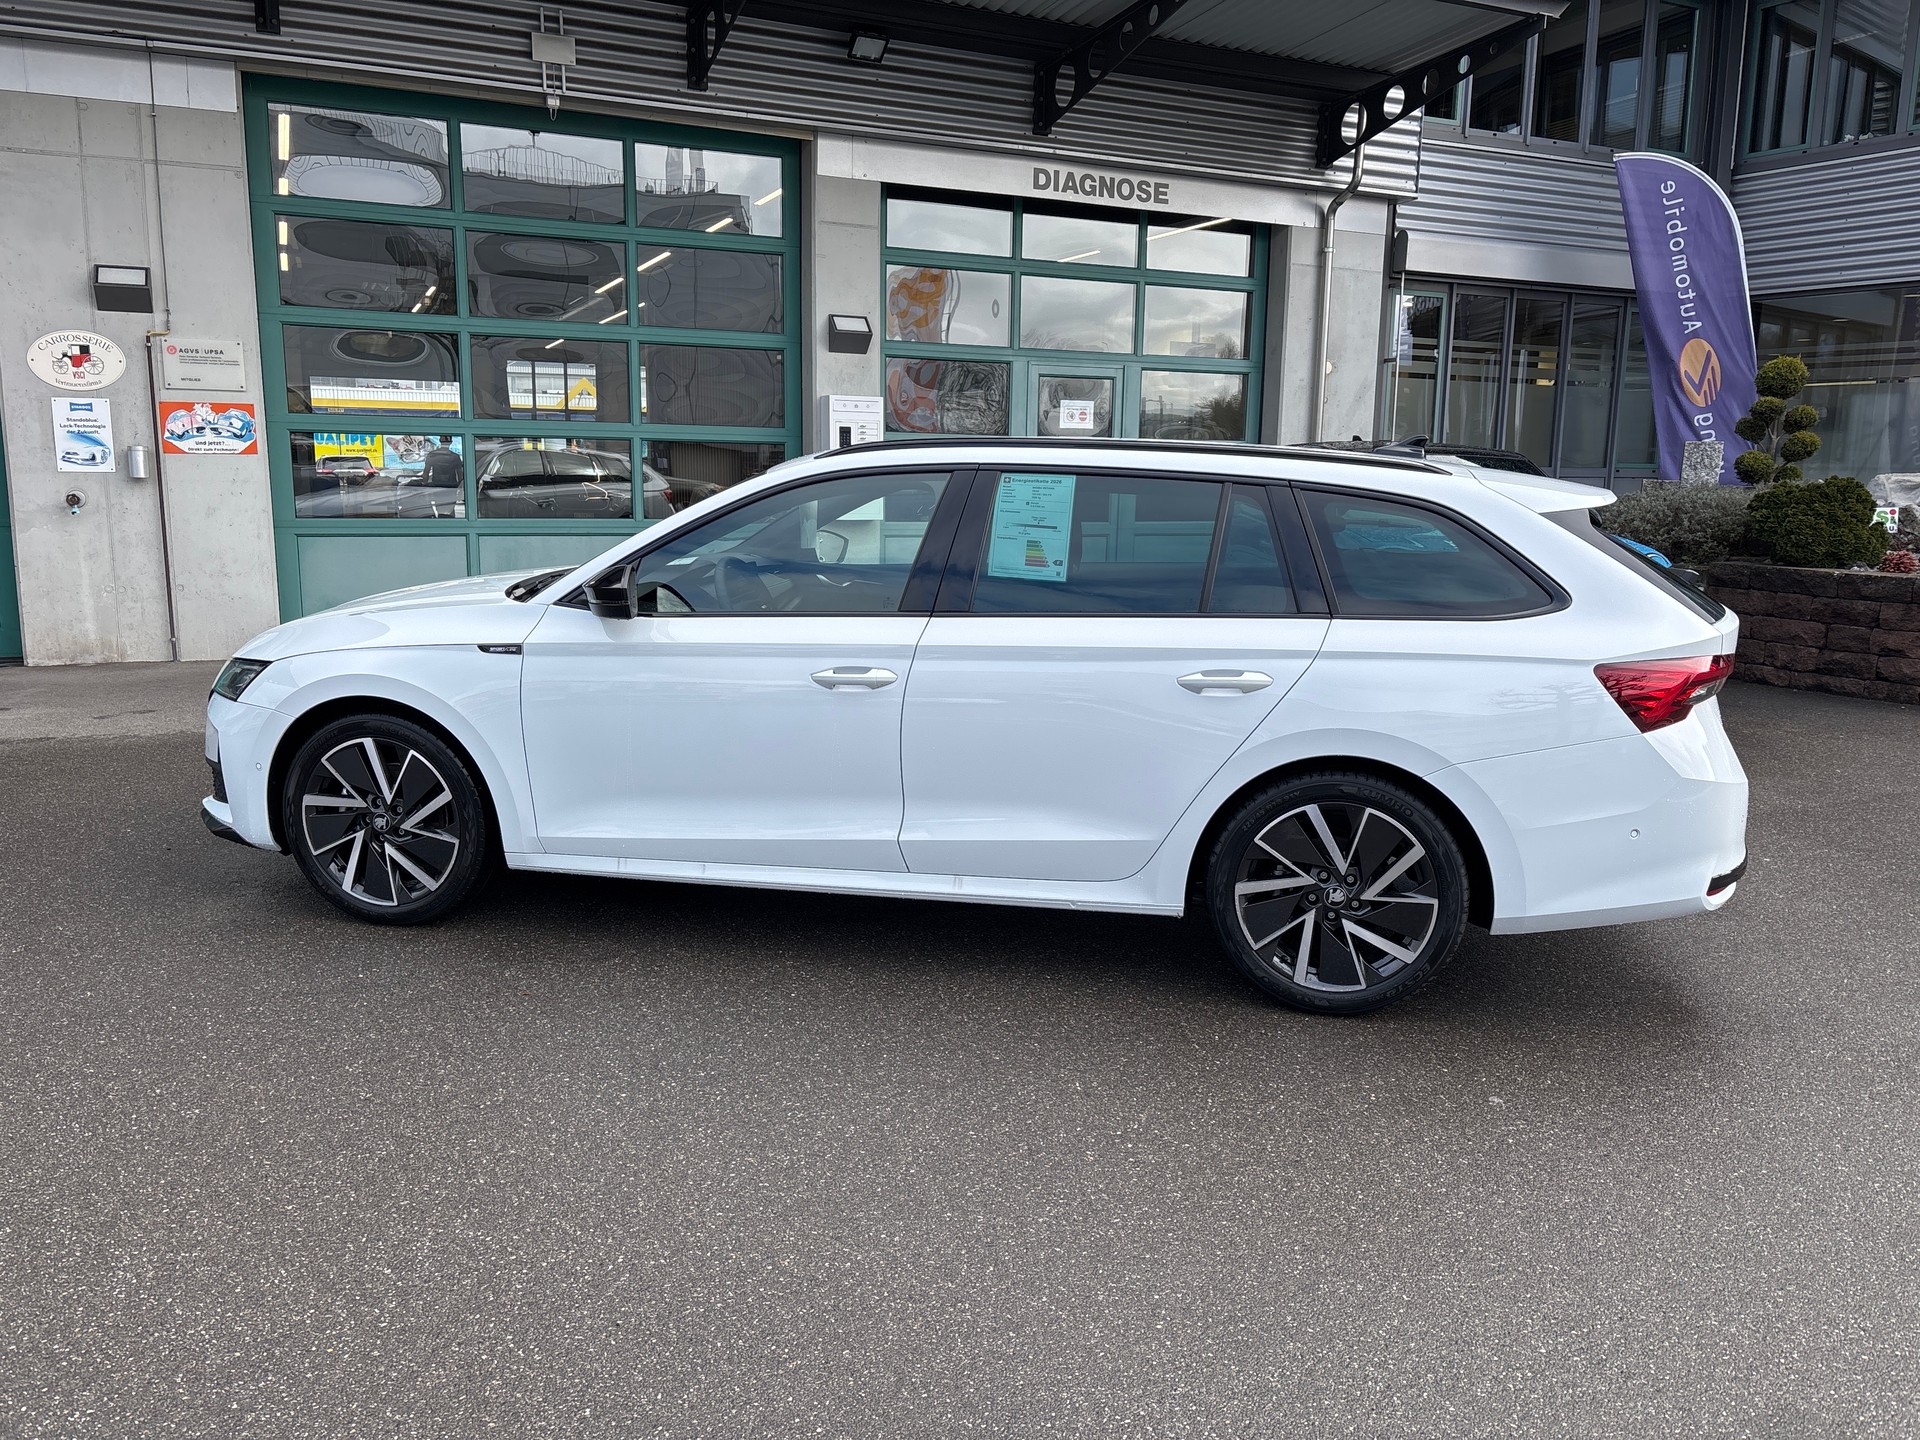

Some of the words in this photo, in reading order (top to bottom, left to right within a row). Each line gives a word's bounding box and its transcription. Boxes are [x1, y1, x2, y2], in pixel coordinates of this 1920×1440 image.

[1033, 167, 1169, 205] DIAGNOSE
[37, 333, 114, 353] CARROSSERIE
[55, 378, 102, 388] Vertrauensfirma
